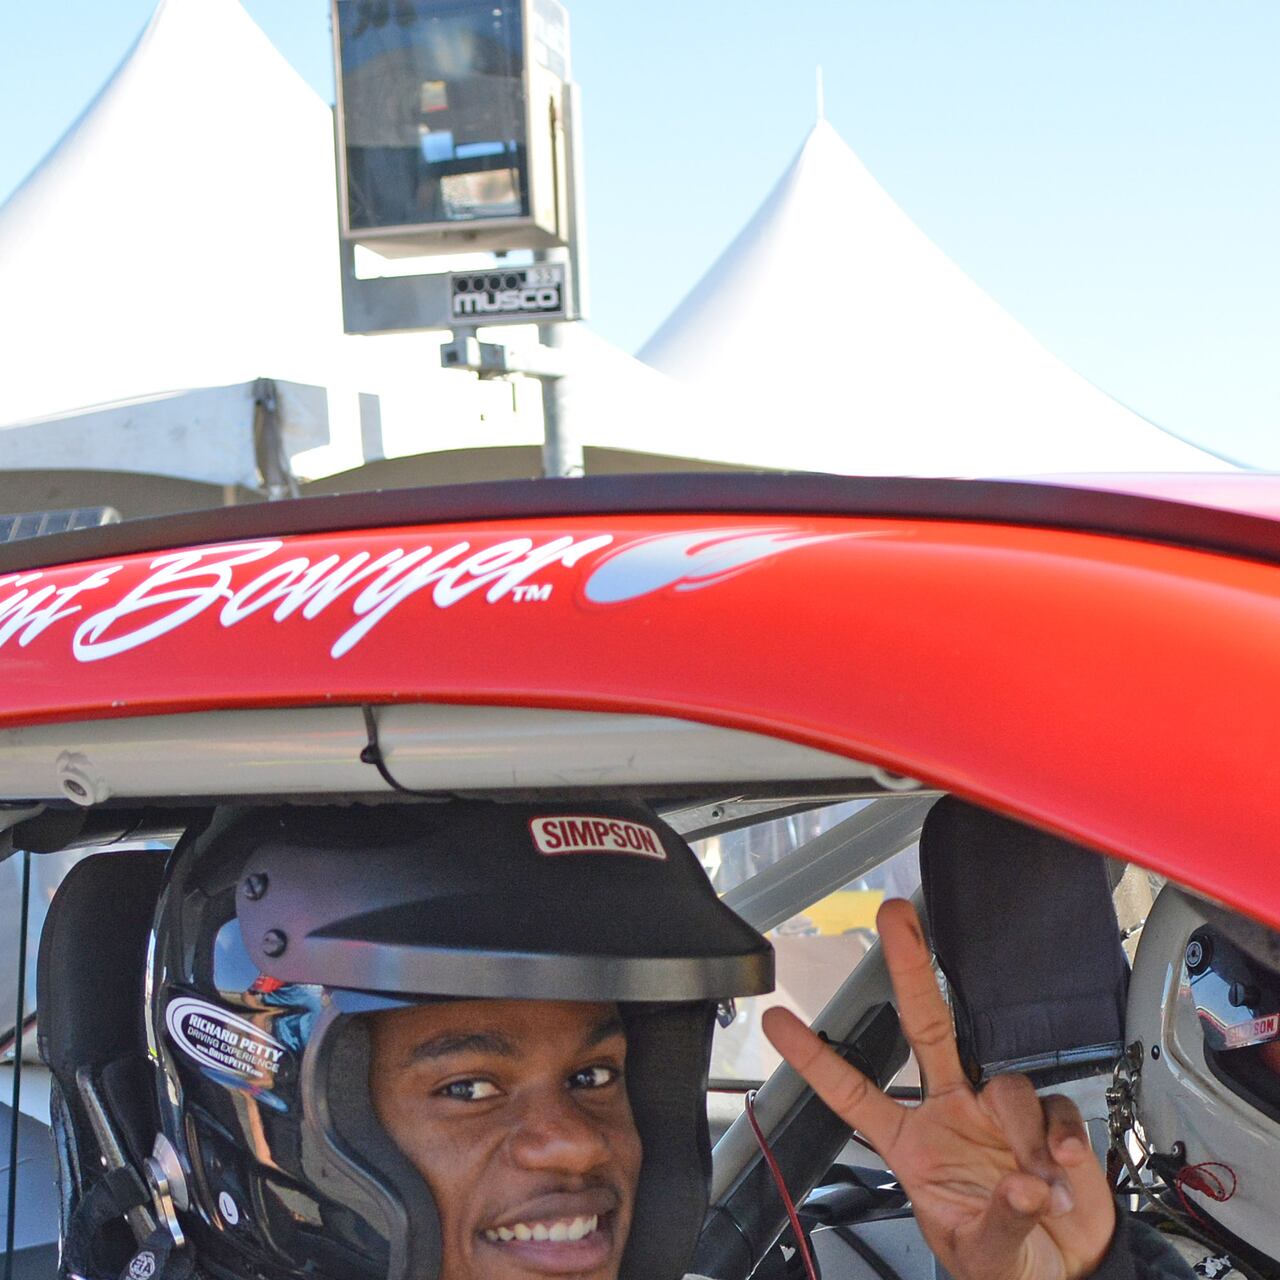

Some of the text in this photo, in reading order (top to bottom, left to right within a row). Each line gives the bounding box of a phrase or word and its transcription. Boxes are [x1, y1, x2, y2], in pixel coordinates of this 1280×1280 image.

[453, 288, 559, 314] musco
[73, 535, 613, 660] Bowyer
[541, 820, 658, 854] SIMPSON
[187, 1027, 280, 1073] DRIVING EXPERIENCE
[188, 1014, 283, 1062] RICHARD PETTY
